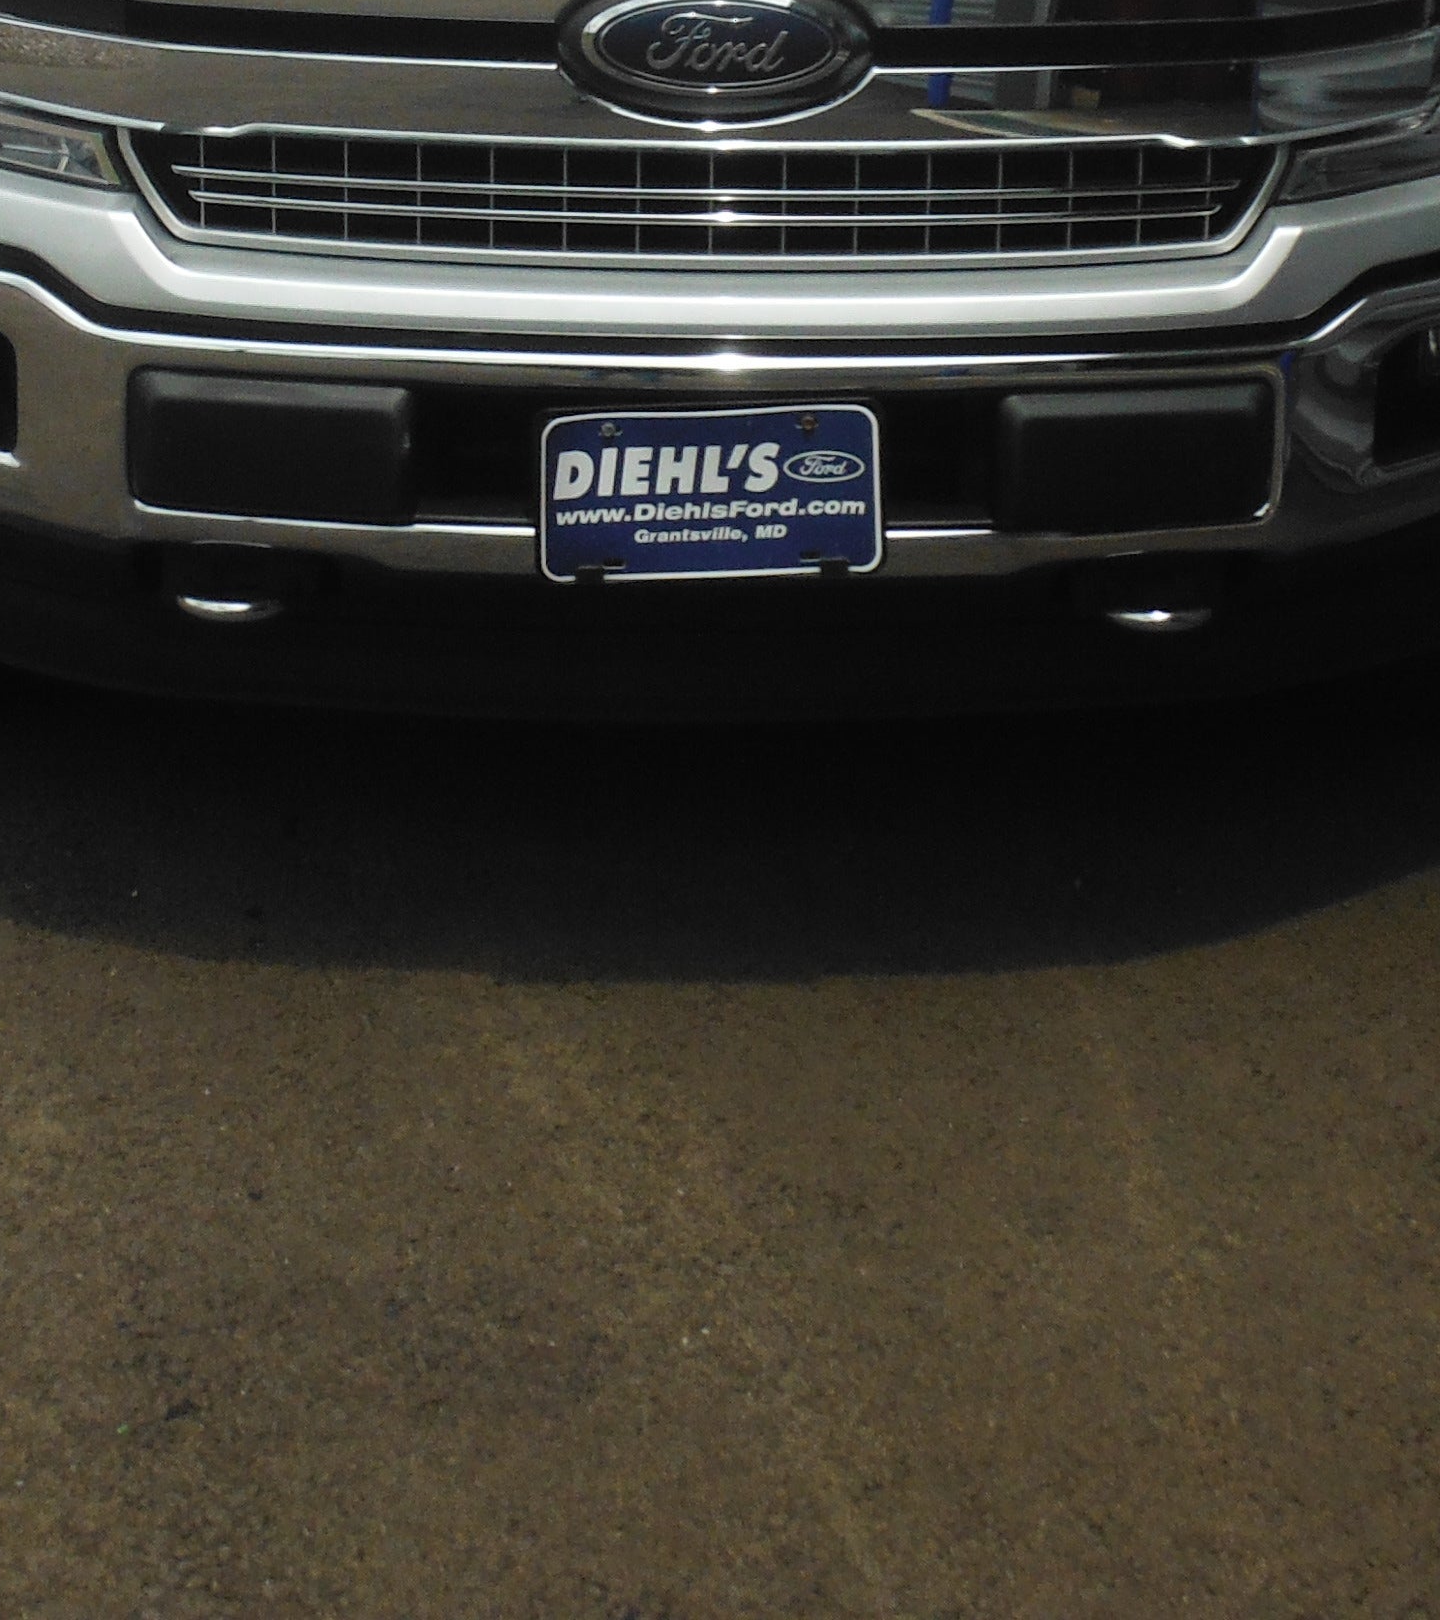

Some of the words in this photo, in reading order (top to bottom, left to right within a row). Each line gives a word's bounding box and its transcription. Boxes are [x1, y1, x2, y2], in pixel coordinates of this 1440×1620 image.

[646, 12, 789, 73] Ford
[553, 442, 780, 500] DIEHL'S
[799, 457, 846, 476] Ford
[556, 498, 866, 525] www.DiehlsFord.com
[634, 527, 748, 543] Grantsville,
[755, 524, 788, 539] MD
